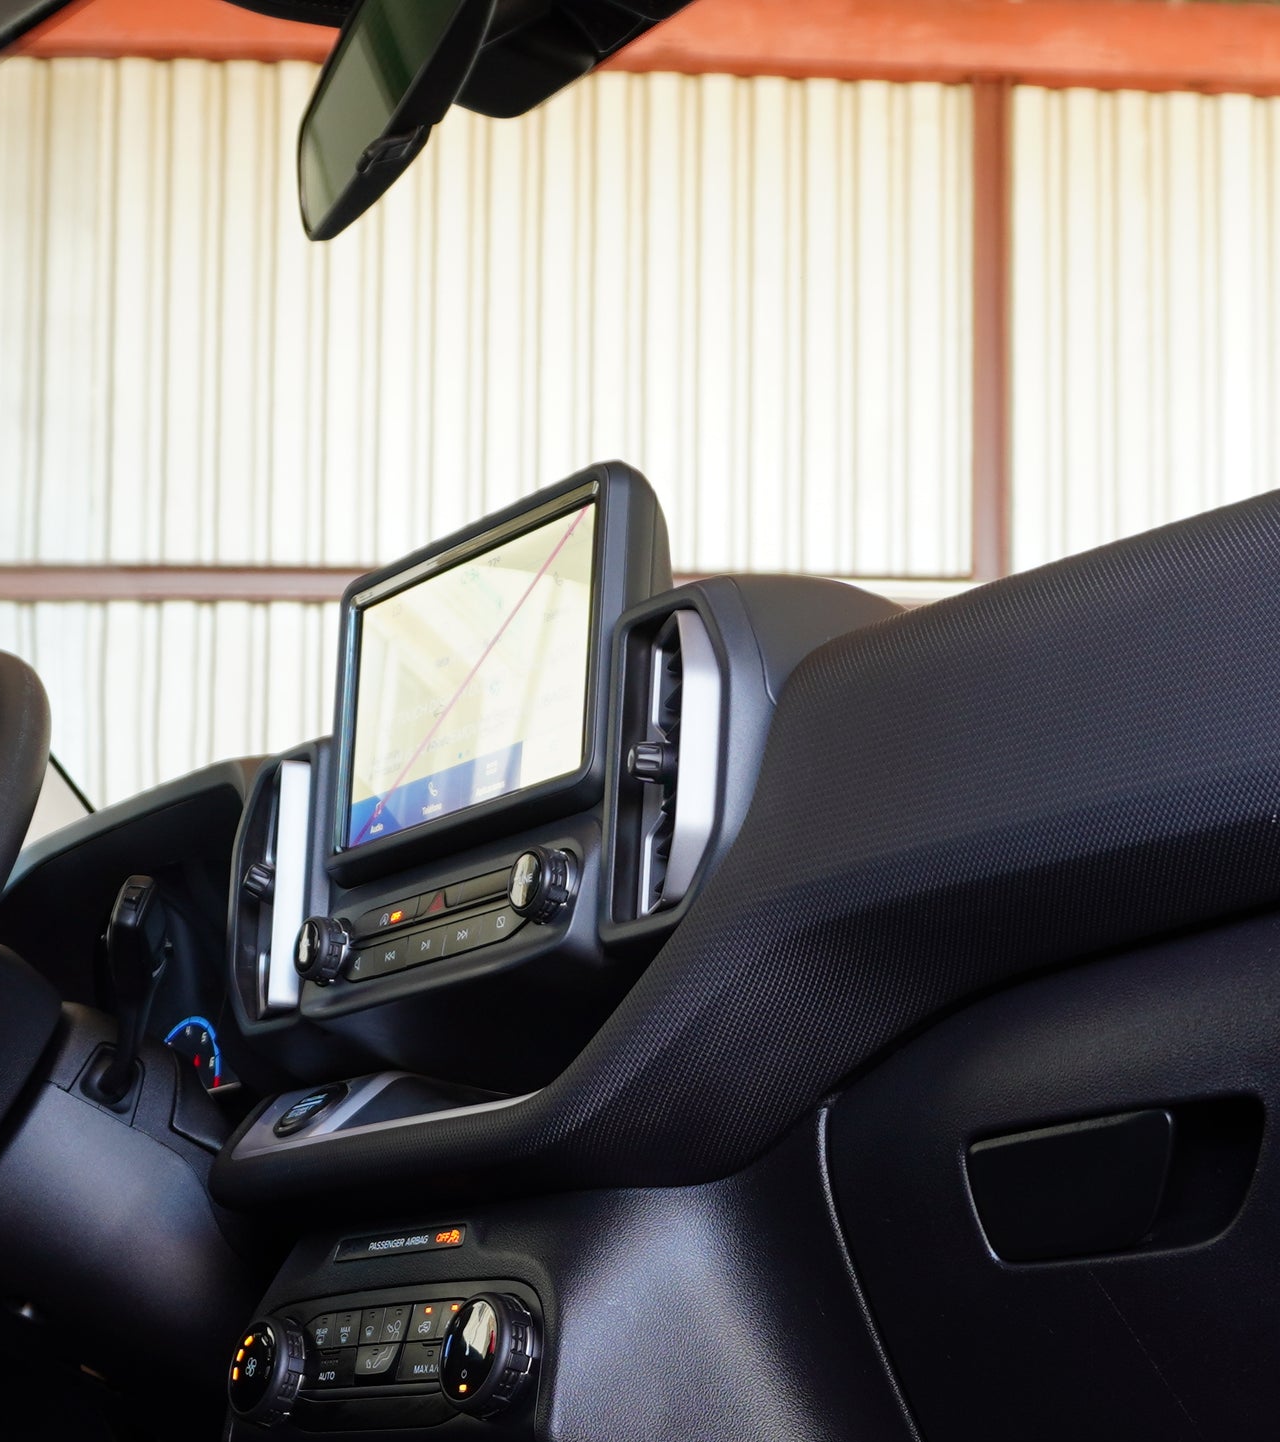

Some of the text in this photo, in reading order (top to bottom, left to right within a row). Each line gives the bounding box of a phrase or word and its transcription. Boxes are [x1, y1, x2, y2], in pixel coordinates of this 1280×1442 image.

[368, 1233, 450, 1251] PASSENGER AIRBAG OFF
[413, 1364, 429, 1374] MAX
[318, 1371, 336, 1381] AUTO
